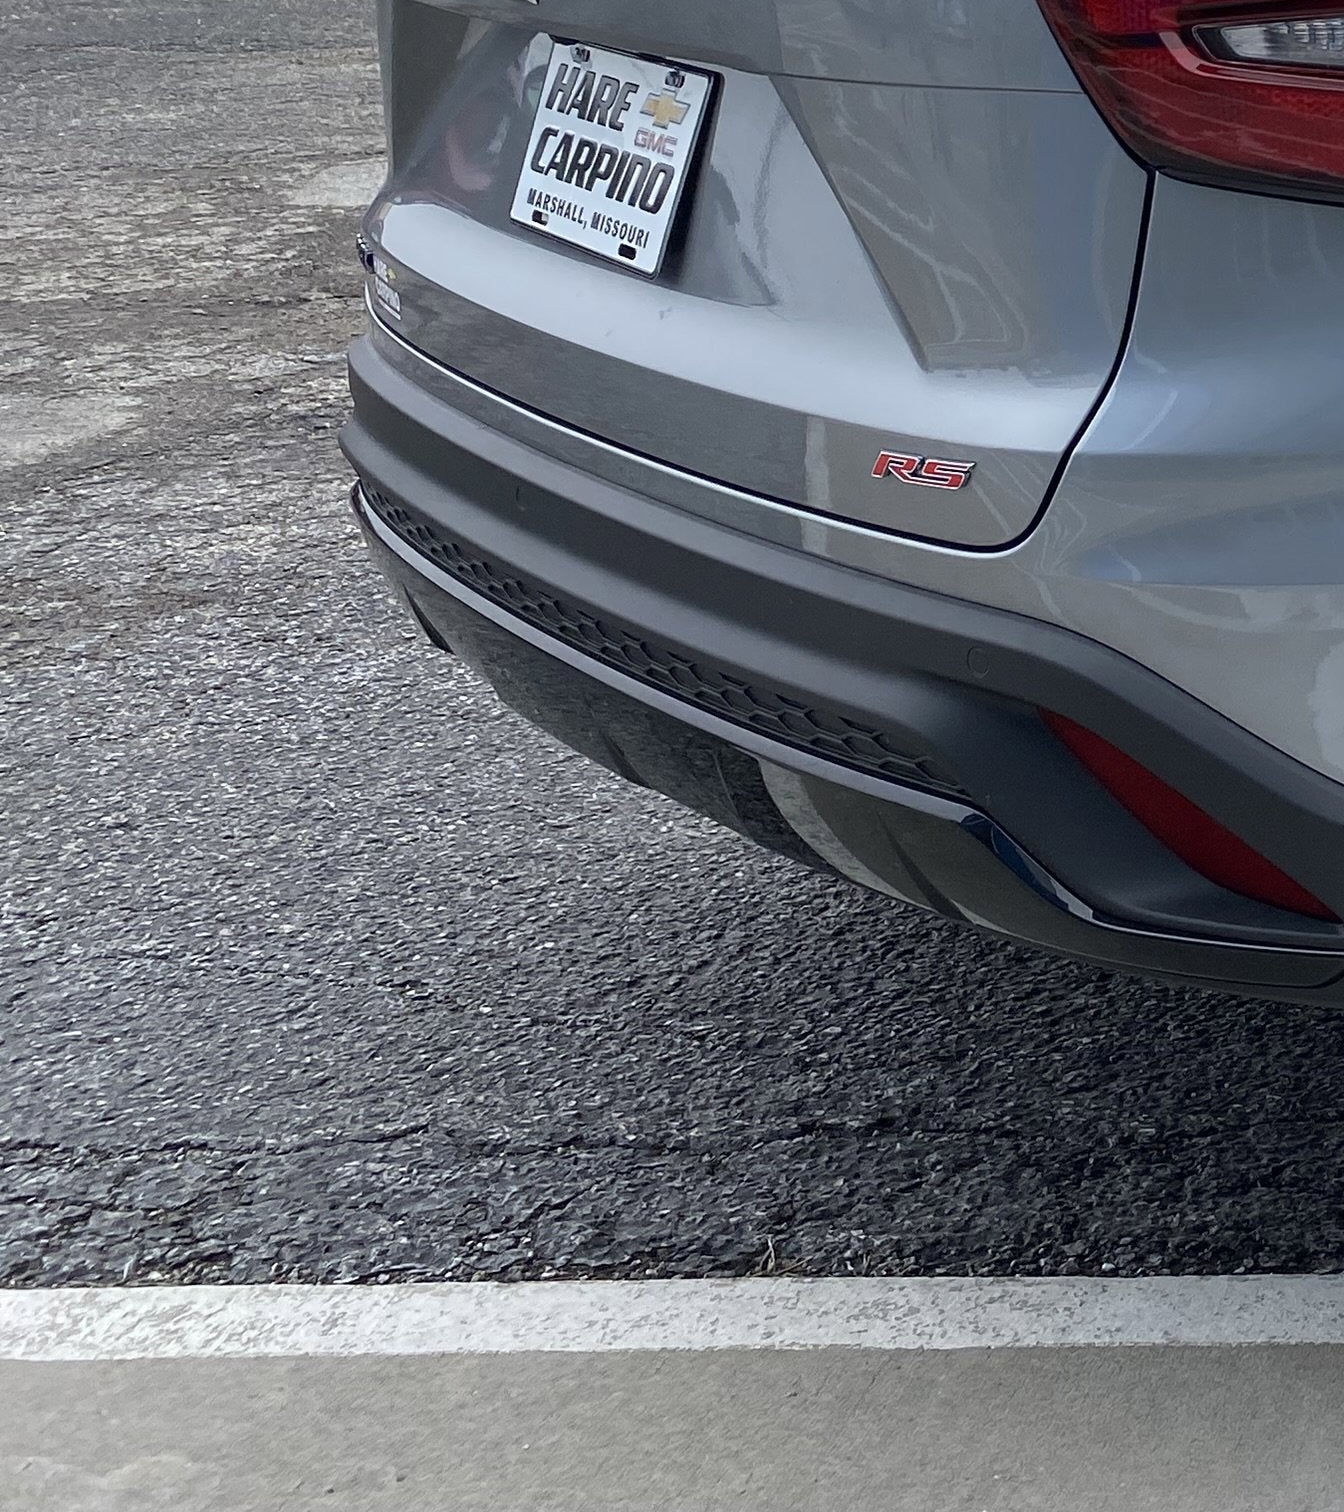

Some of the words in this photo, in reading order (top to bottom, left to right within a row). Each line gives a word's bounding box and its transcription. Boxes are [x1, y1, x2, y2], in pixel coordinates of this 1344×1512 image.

[545, 63, 640, 132] HARE
[530, 125, 676, 216] CARPINO
[634, 127, 678, 158] GMC
[526, 188, 588, 231] MARSHALL,
[590, 211, 650, 249] MISSOURI
[871, 449, 977, 490] RS
